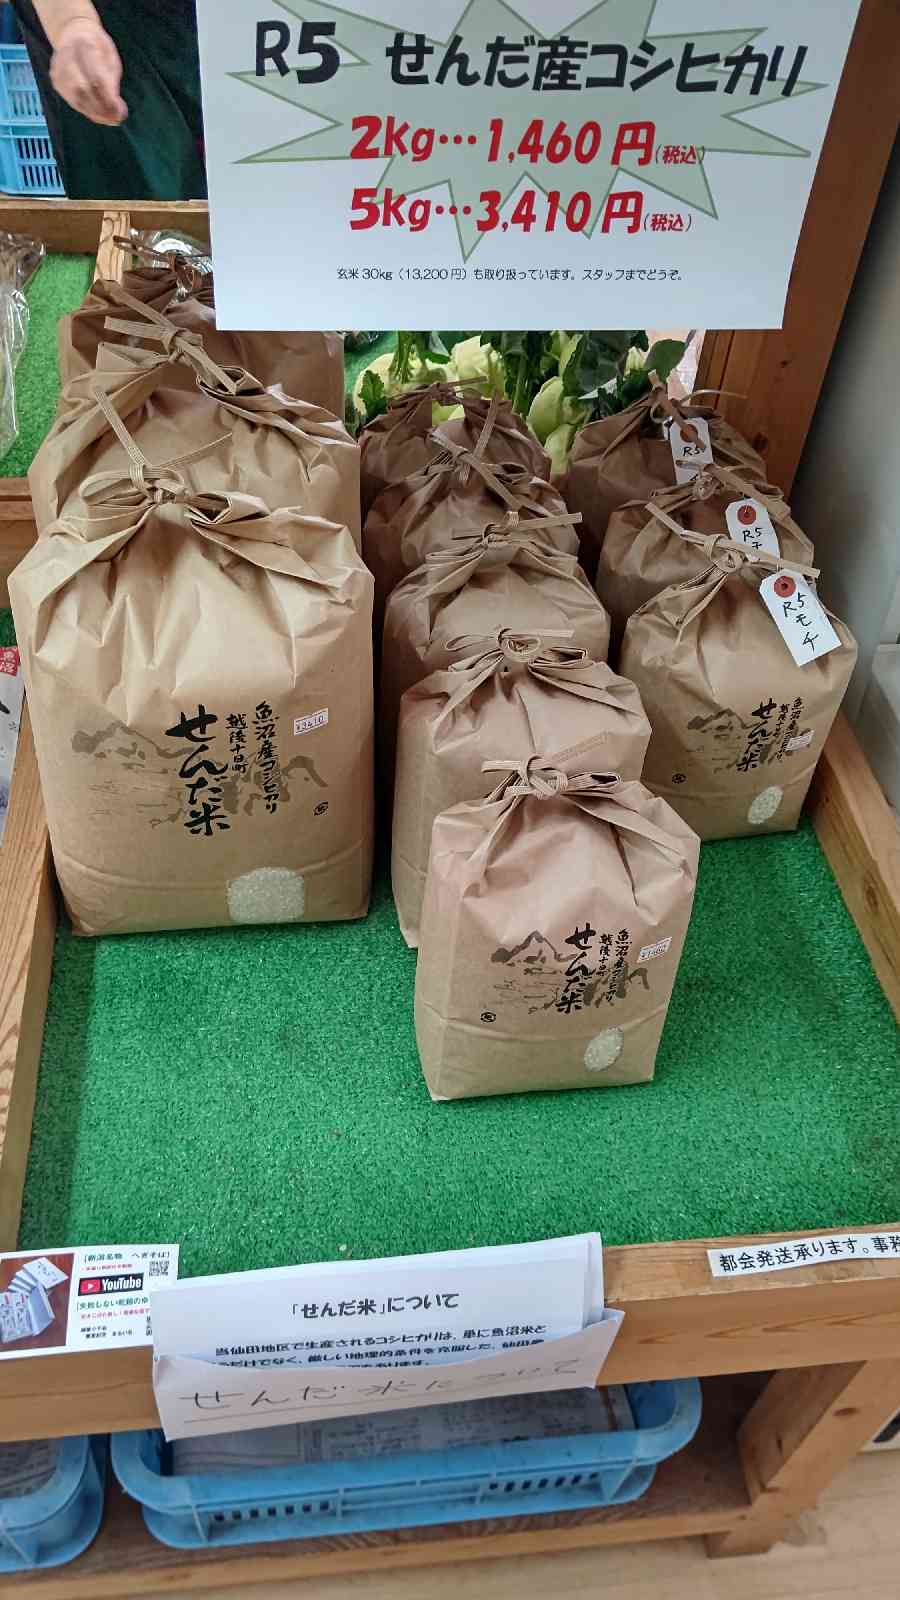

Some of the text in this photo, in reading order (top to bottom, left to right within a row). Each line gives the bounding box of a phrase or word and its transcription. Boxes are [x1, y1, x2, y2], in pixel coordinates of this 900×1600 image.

[255, 20, 808, 97] R5 せんだ産コシヒカリ
[742, 527, 763, 542] R5
[781, 592, 809, 618] R5
[736, 698, 778, 772] せんだ米
[164, 703, 231, 837] せんだ米
[555, 922, 597, 1014] せんだ米
[102, 1276, 142, 1291] YouTube
[290, 1292, 460, 1320] 「せんだ米」について
